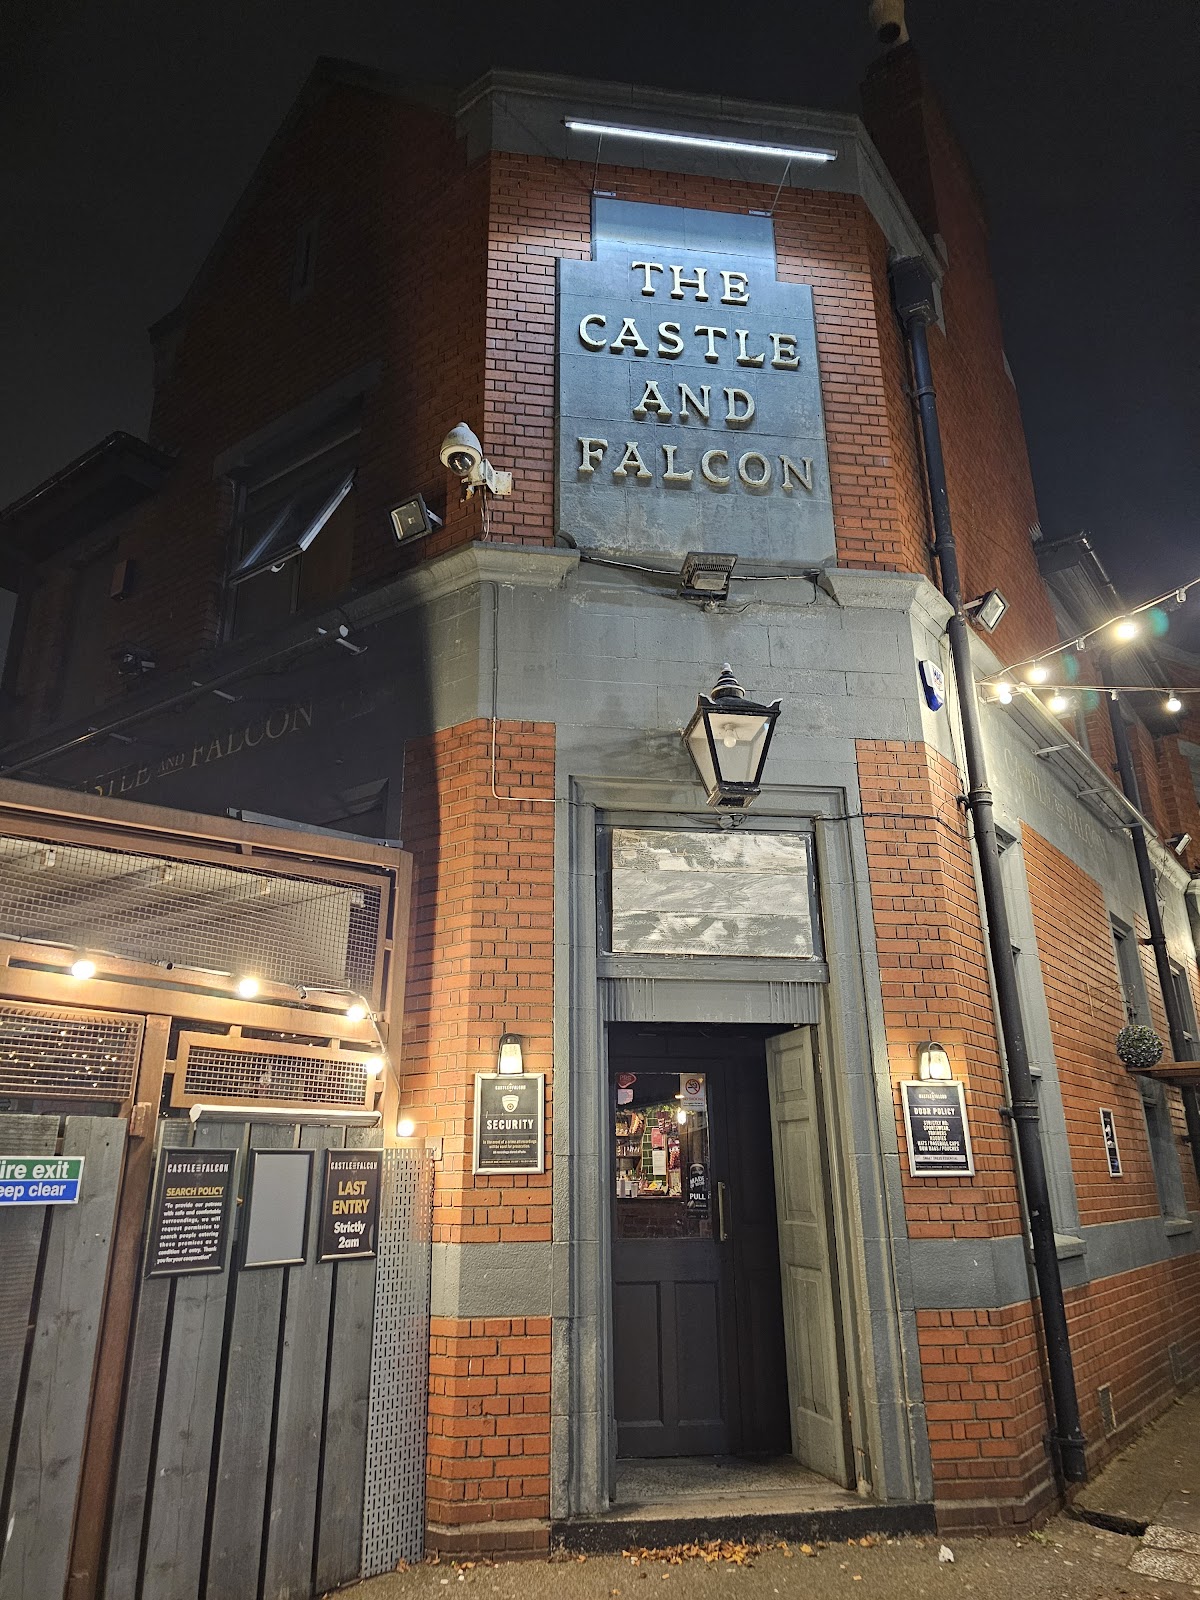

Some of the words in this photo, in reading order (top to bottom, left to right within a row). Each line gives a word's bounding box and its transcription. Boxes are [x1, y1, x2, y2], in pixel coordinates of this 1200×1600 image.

[631, 261, 750, 305] THE
[579, 313, 800, 368] CASTLE
[633, 380, 755, 423] AND
[578, 436, 813, 490] FALCON
[190, 704, 313, 768] FALCON
[932, 1108, 955, 1116] POLICY
[487, 1120, 534, 1130] SECURITY
[0, 1160, 27, 1179] ire
[32, 1161, 69, 1179] exit
[168, 1164, 196, 1173] CASTLE
[202, 1164, 229, 1173] FALCON
[330, 1162, 352, 1170] CASTLE
[357, 1162, 378, 1170] FALCON
[28, 1182, 66, 1197] clear
[166, 1187, 197, 1196] SEARCH
[198, 1186, 224, 1196] POLICY
[338, 1181, 367, 1196] LAST
[332, 1199, 370, 1215] ENTRY
[333, 1220, 366, 1235] Strictly
[338, 1236, 360, 1249] 2am
